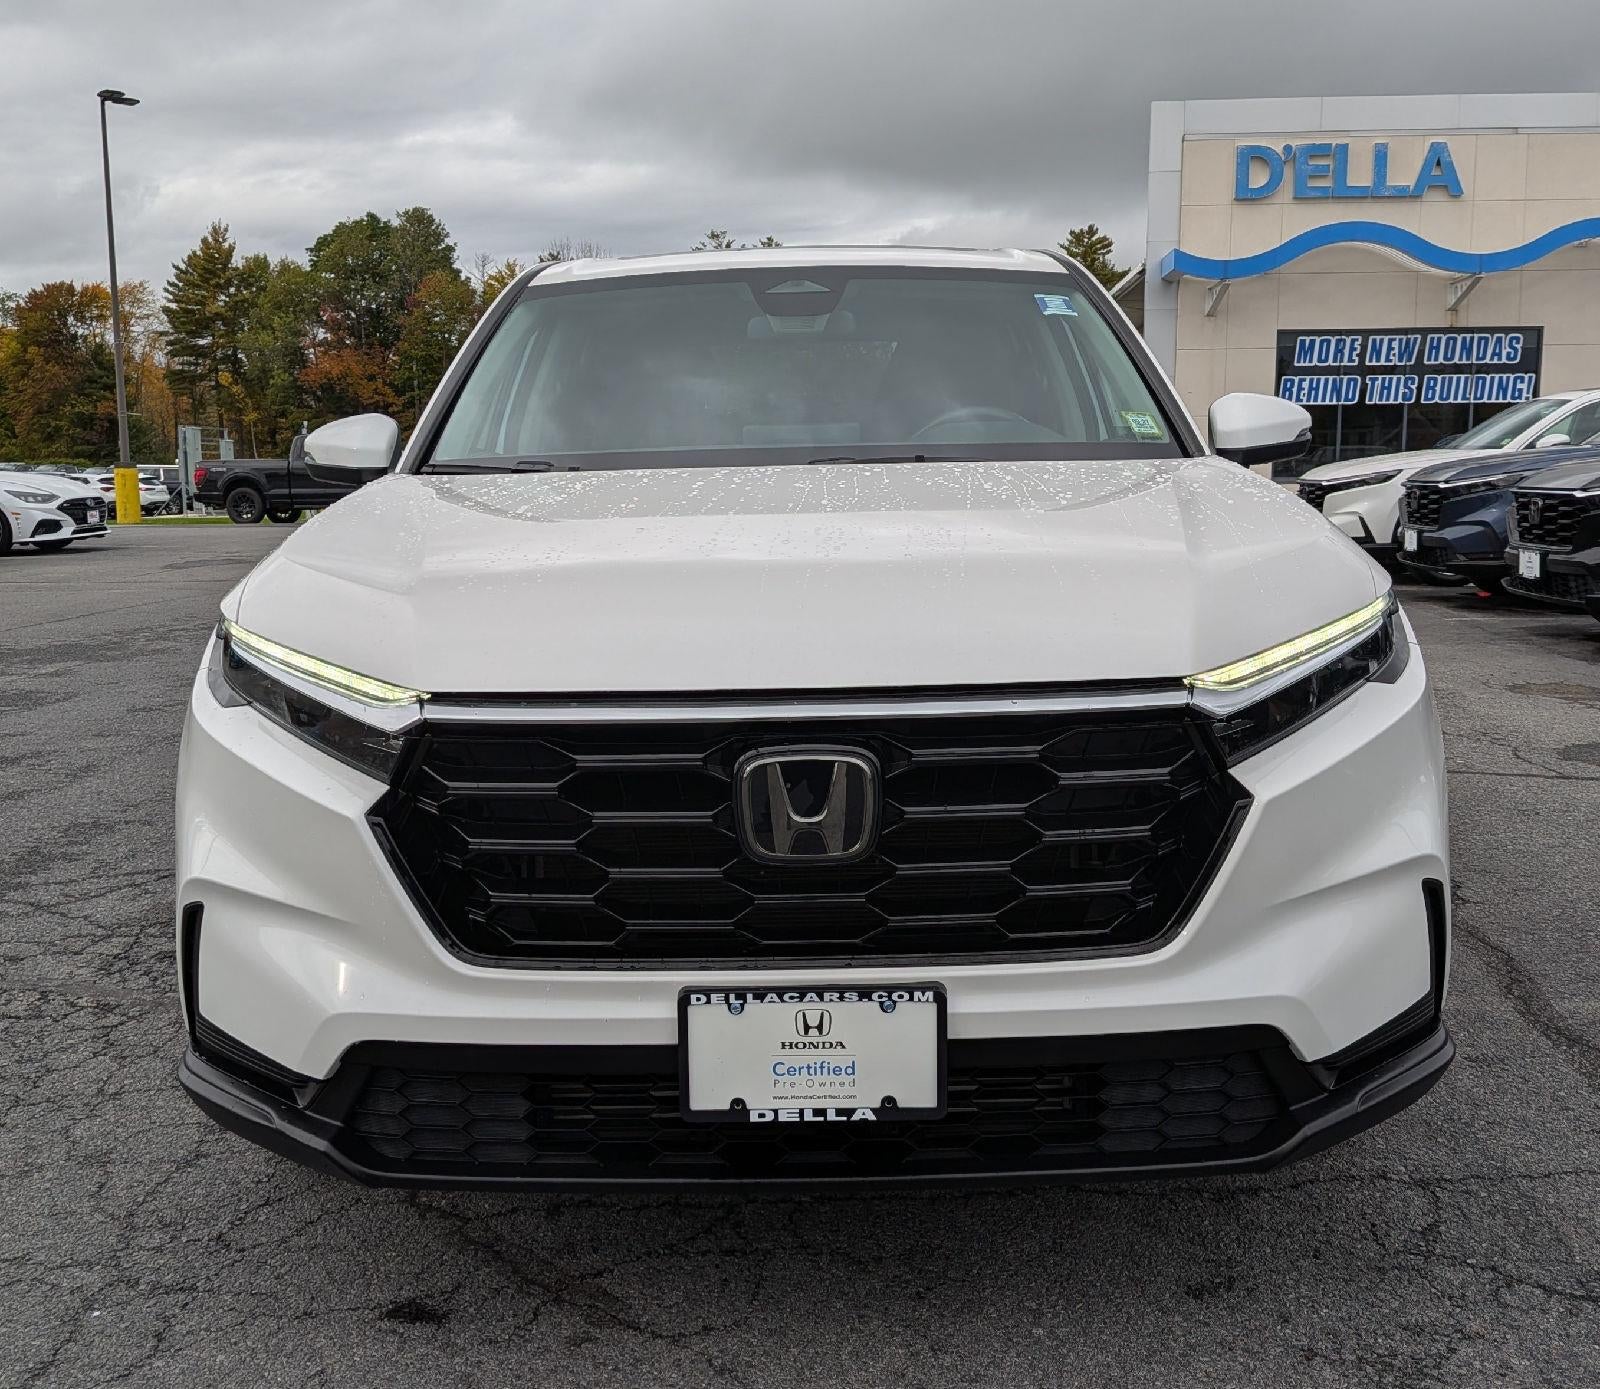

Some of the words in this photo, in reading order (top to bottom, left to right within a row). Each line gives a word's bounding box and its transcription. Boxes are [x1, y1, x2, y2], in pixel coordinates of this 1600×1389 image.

[1234, 141, 1464, 200] D'ELLA
[1294, 335, 1362, 367] MORE
[1365, 334, 1421, 366] NEW
[1424, 333, 1523, 364] HONDAS
[1280, 375, 1361, 405] BEHIND
[1366, 374, 1418, 404] THIS
[1421, 373, 1535, 403] BUILDING!
[690, 990, 934, 1005] DELLACARS.COM
[780, 1041, 847, 1050] HONDA
[772, 1060, 856, 1077] Certified
[773, 1078, 856, 1089] Pre-Owned
[749, 1108, 877, 1122] DELLA
